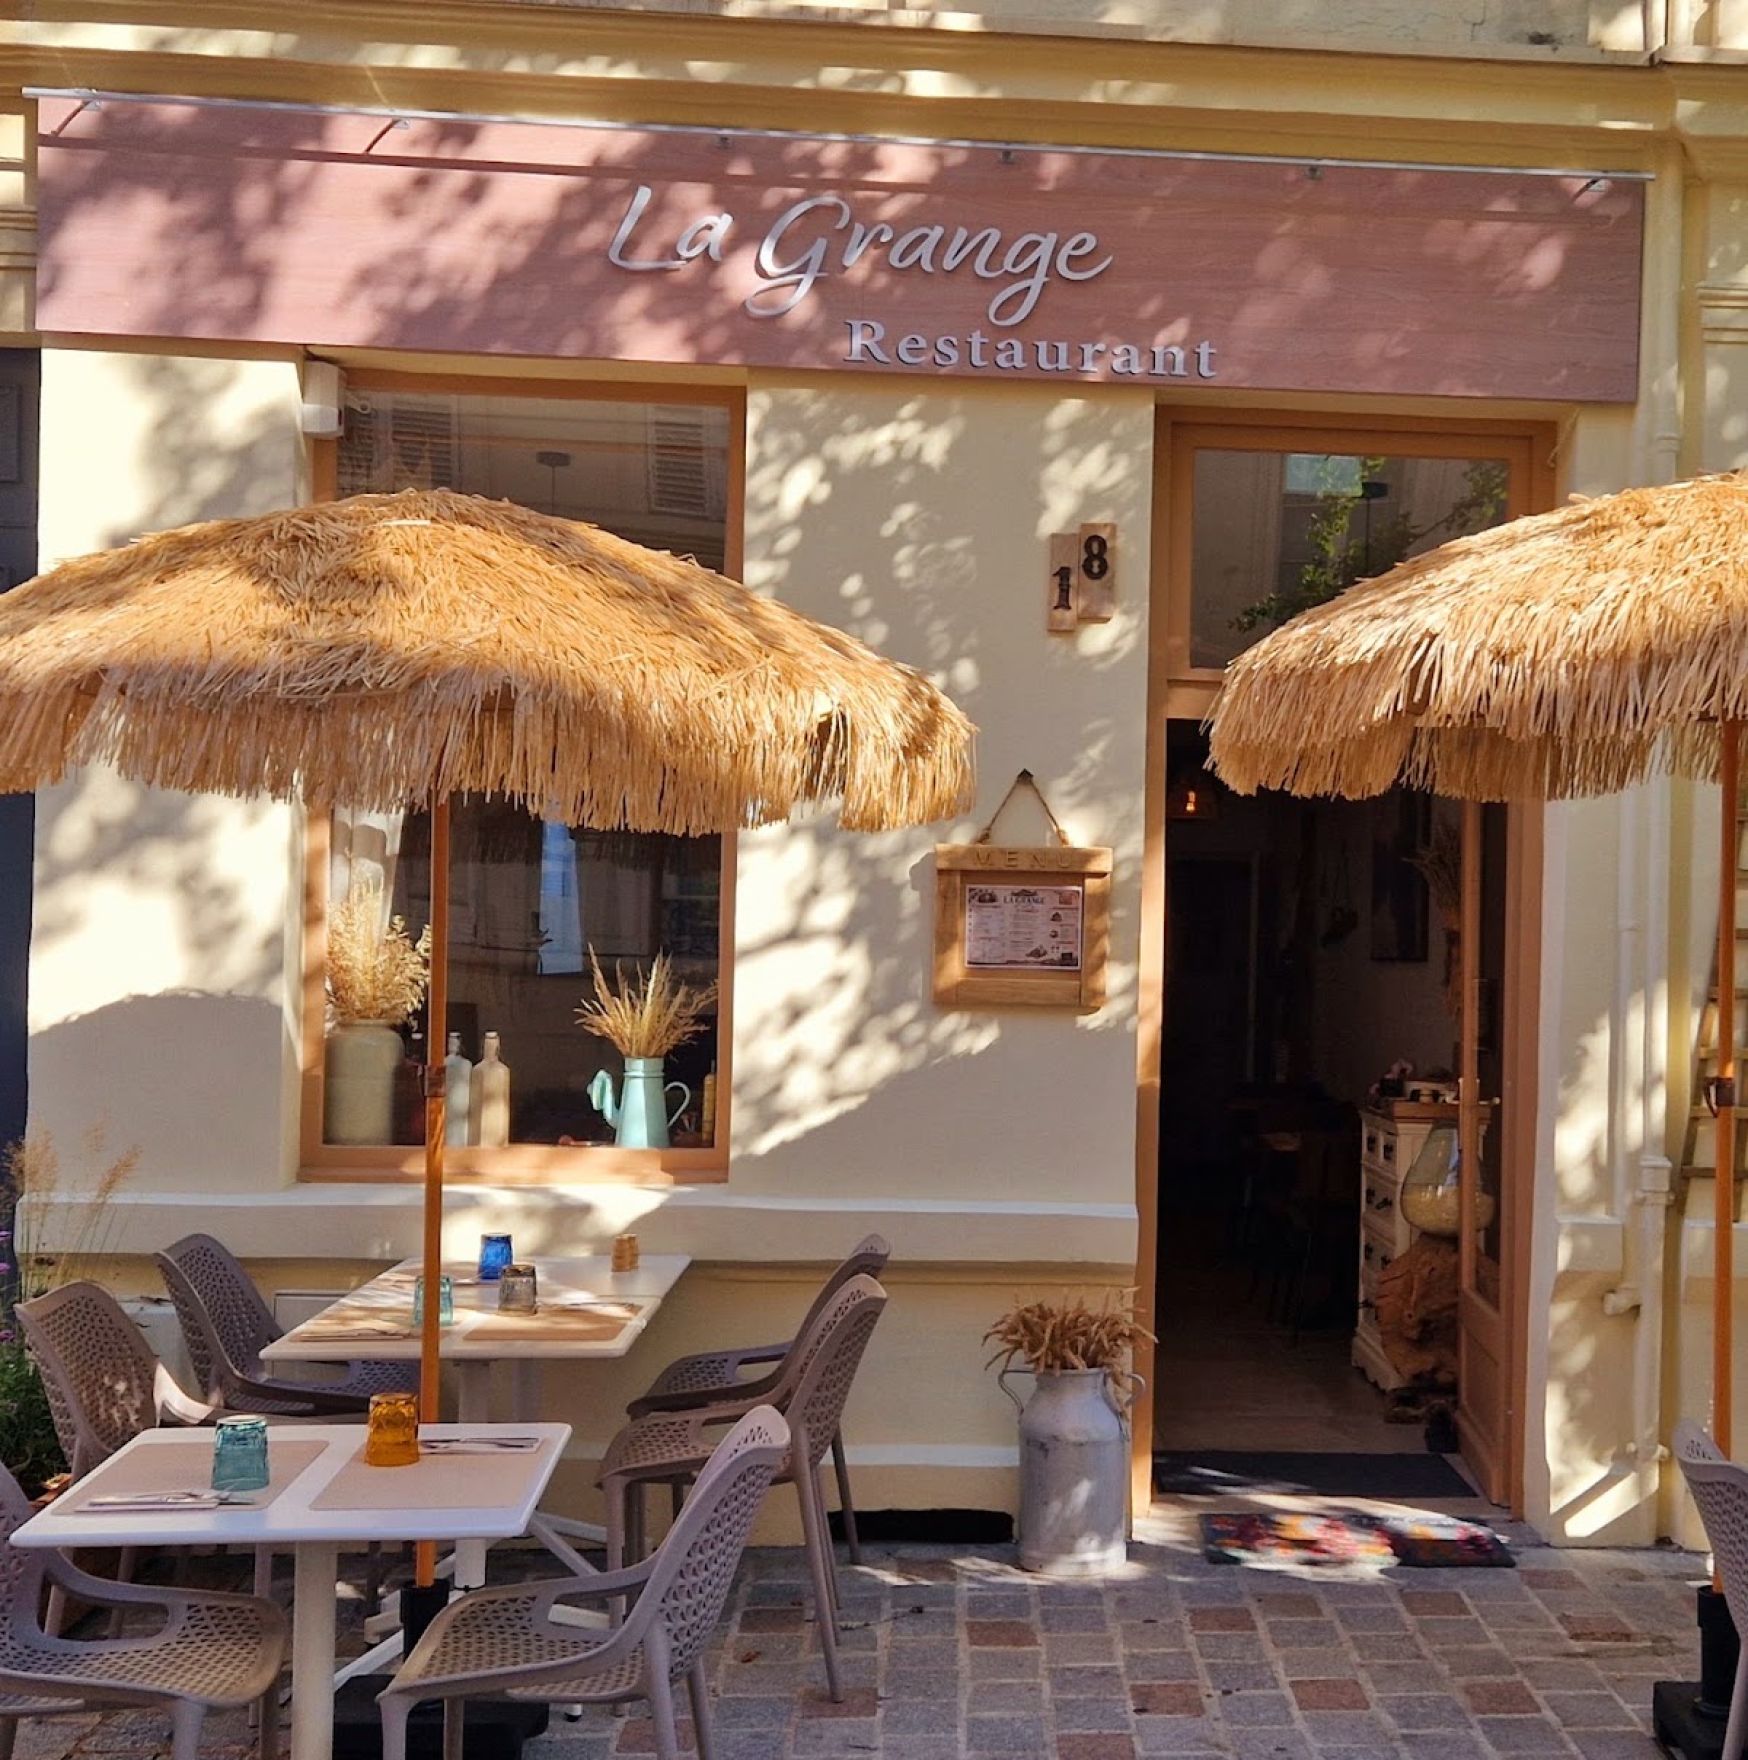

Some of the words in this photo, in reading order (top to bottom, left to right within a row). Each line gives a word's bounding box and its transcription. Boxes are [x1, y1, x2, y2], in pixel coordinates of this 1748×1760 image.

[607, 184, 734, 270] La
[745, 194, 1112, 326] Grange
[844, 319, 1217, 378] Restaurant
[974, 851, 1072, 868] MENU
